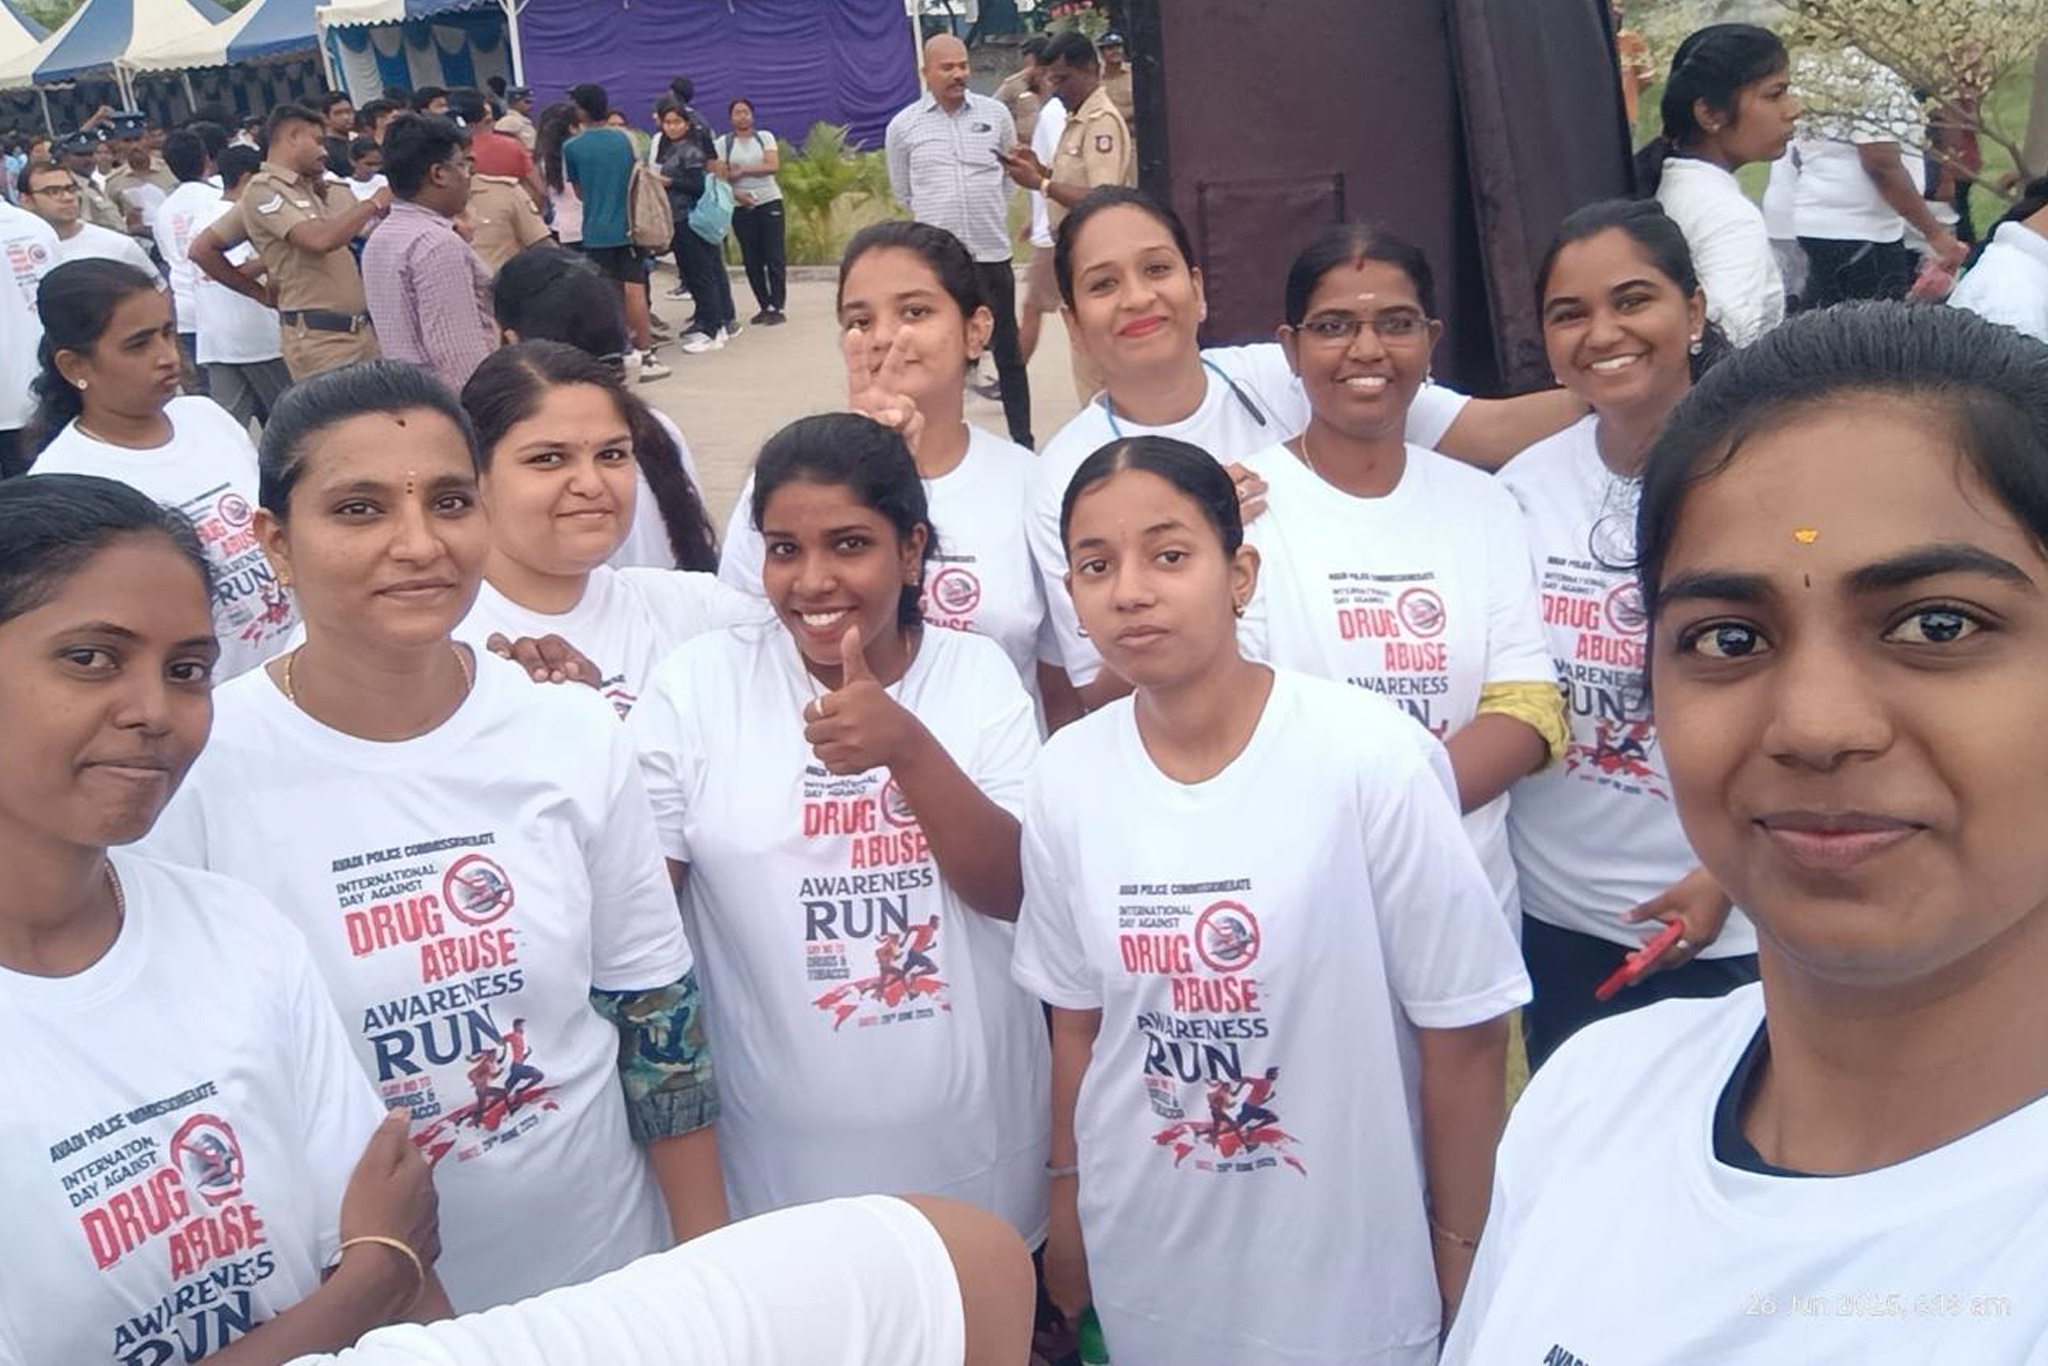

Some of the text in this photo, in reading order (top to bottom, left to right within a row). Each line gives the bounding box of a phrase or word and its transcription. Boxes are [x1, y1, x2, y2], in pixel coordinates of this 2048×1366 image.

[1337, 608, 1401, 640] DRUG
[1542, 593, 1601, 631] DRUG
[1385, 642, 1448, 672] ABUSE
[803, 799, 876, 836] DRUG
[850, 830, 929, 869] ABUSE
[336, 864, 438, 895] INTERNATIONAL
[338, 879, 423, 908] DAY AGAINST
[799, 867, 933, 898] AWARENESS
[344, 893, 446, 957] DRUG
[803, 894, 909, 941] RUN
[421, 928, 518, 984] ABUSE
[1119, 933, 1194, 974] DRUG
[363, 970, 525, 1034] AWARENESS
[1171, 976, 1262, 1013] ABUSE
[367, 1003, 504, 1082] RUN
[1137, 1010, 1269, 1040] AWARENESS
[1143, 1030, 1242, 1084] RUN
[85, 1113, 127, 1144] POLICE
[68, 1150, 157, 1208] DAY AGAINST
[80, 1166, 190, 1271] DRUG
